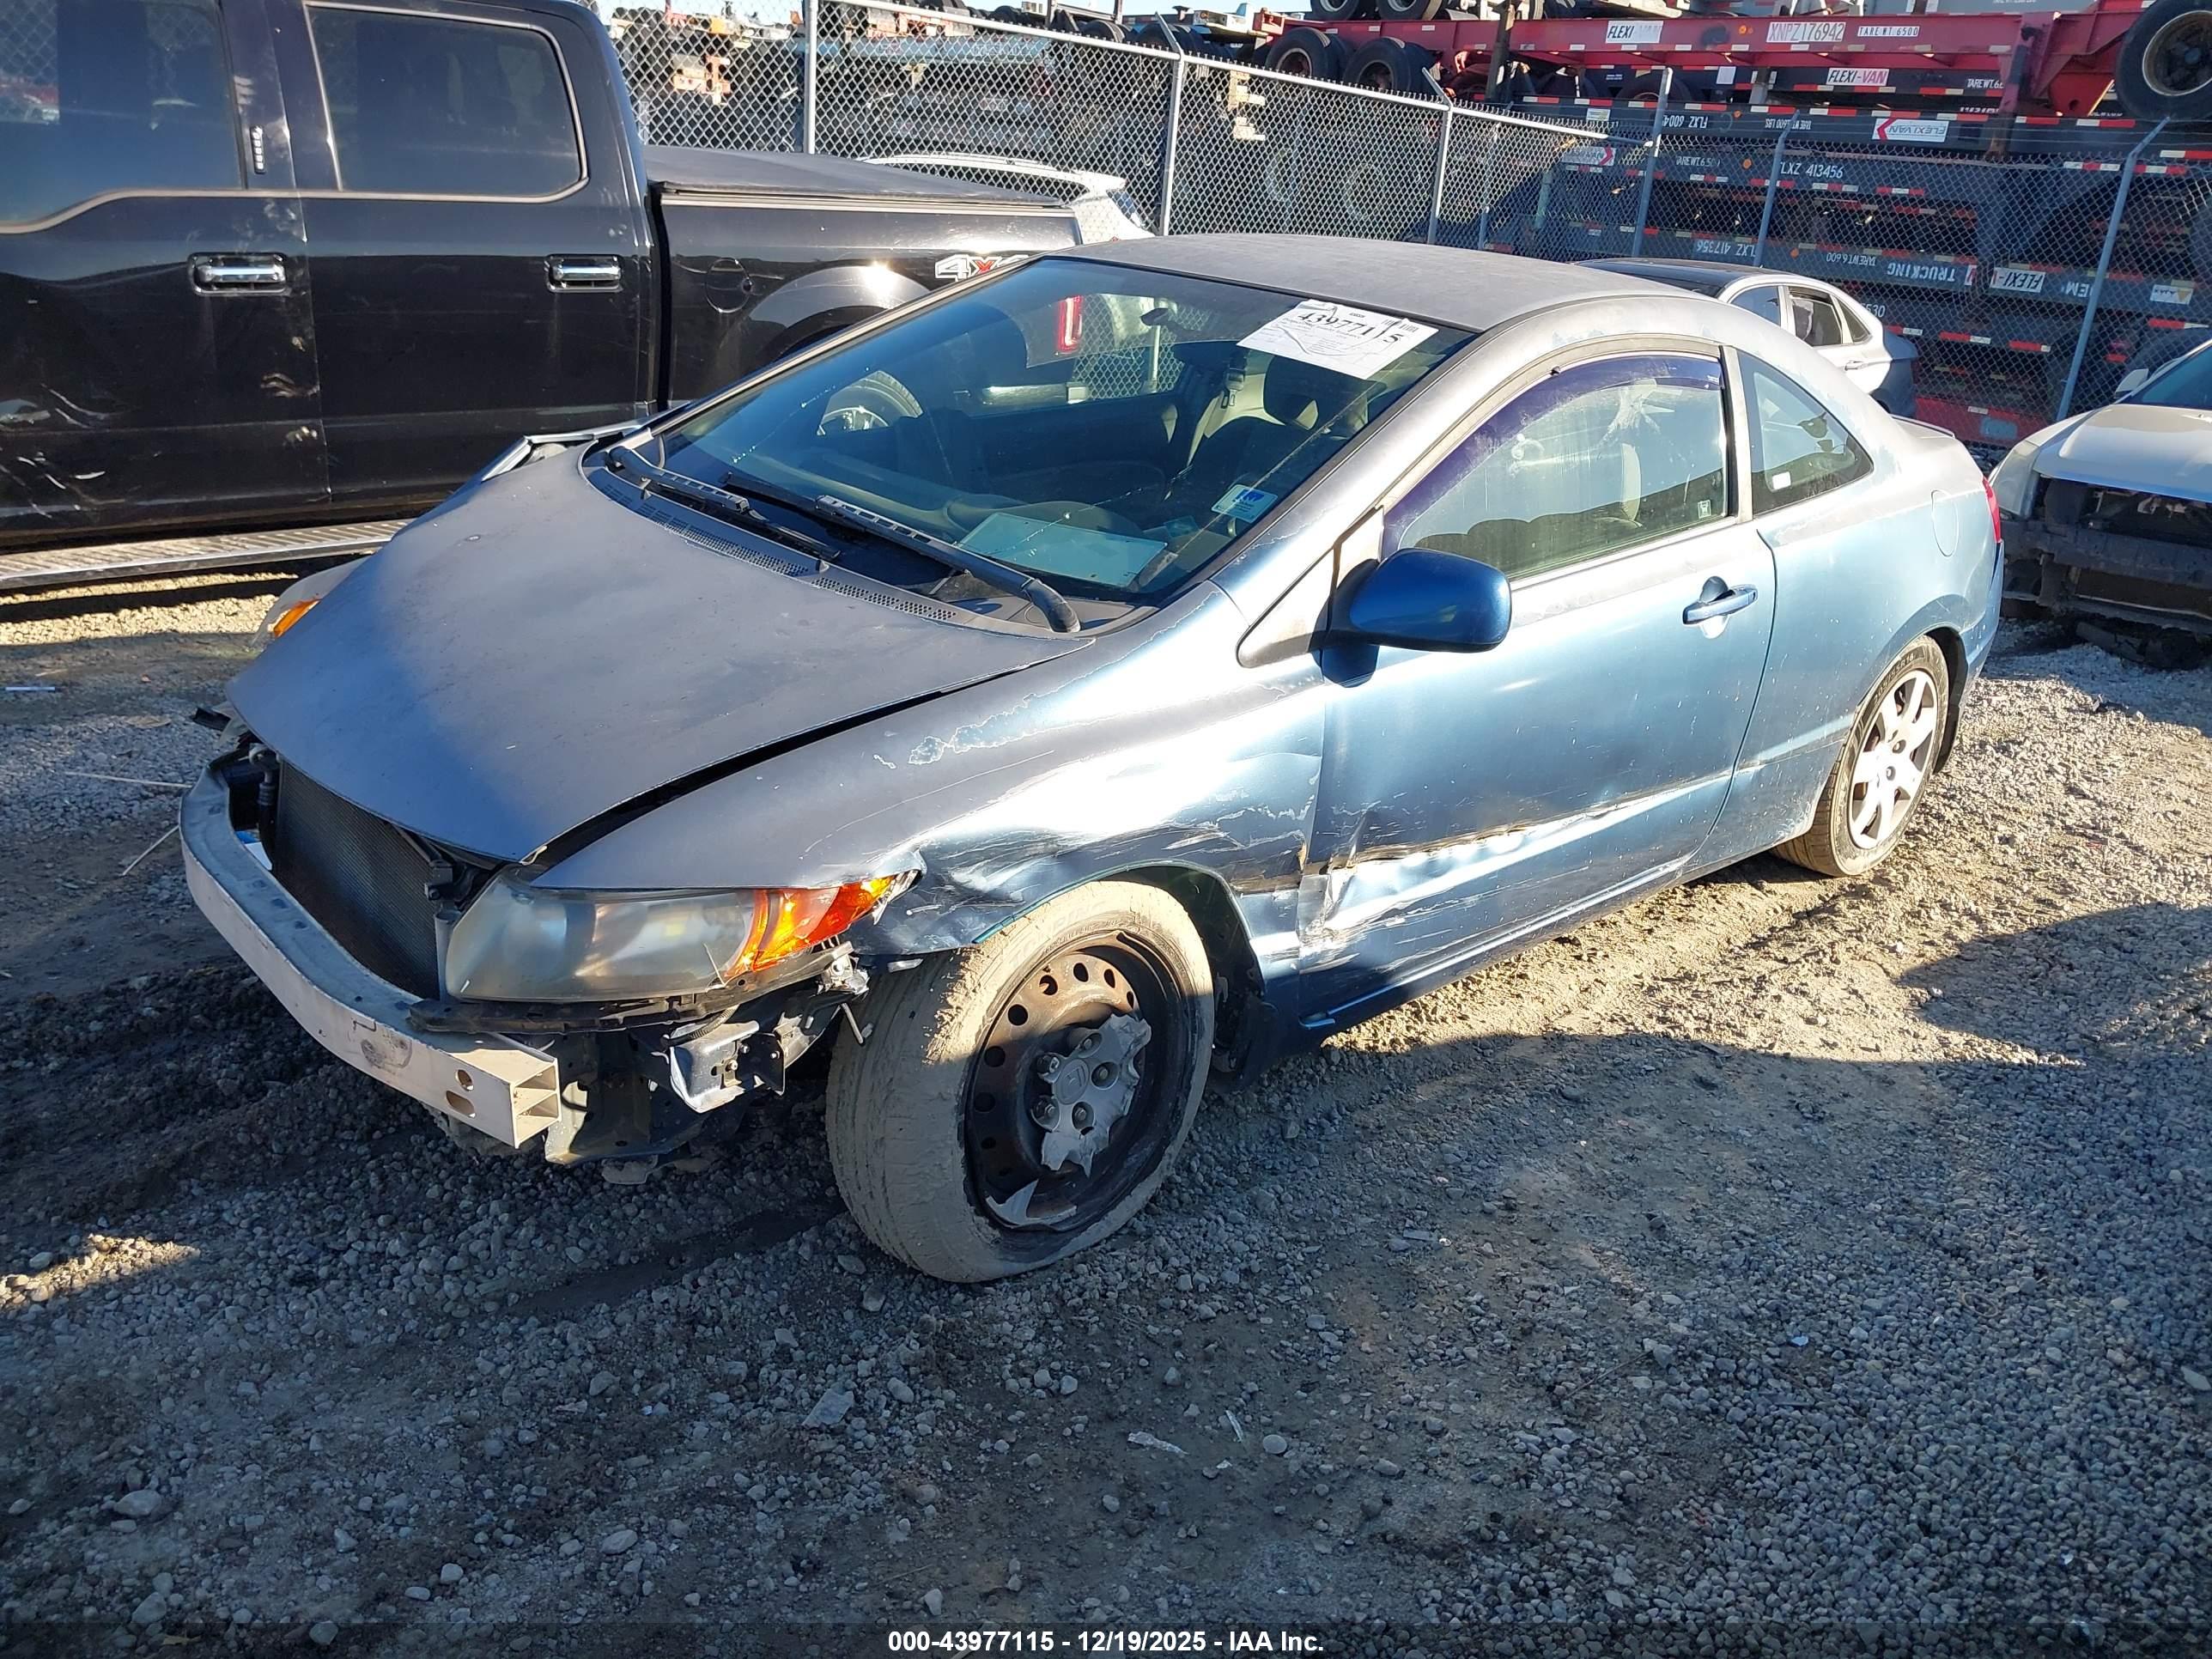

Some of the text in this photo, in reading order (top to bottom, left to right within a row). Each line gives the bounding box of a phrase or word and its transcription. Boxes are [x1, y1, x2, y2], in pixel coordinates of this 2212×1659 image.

[1828, 70, 1887, 83] FLEXI-VAN
[1688, 116, 1709, 128] FLXZ
[1806, 163, 1845, 179] 413456
[1696, 240, 1757, 258] LXZ 417356
[1887, 261, 1956, 282] TRUCKING
